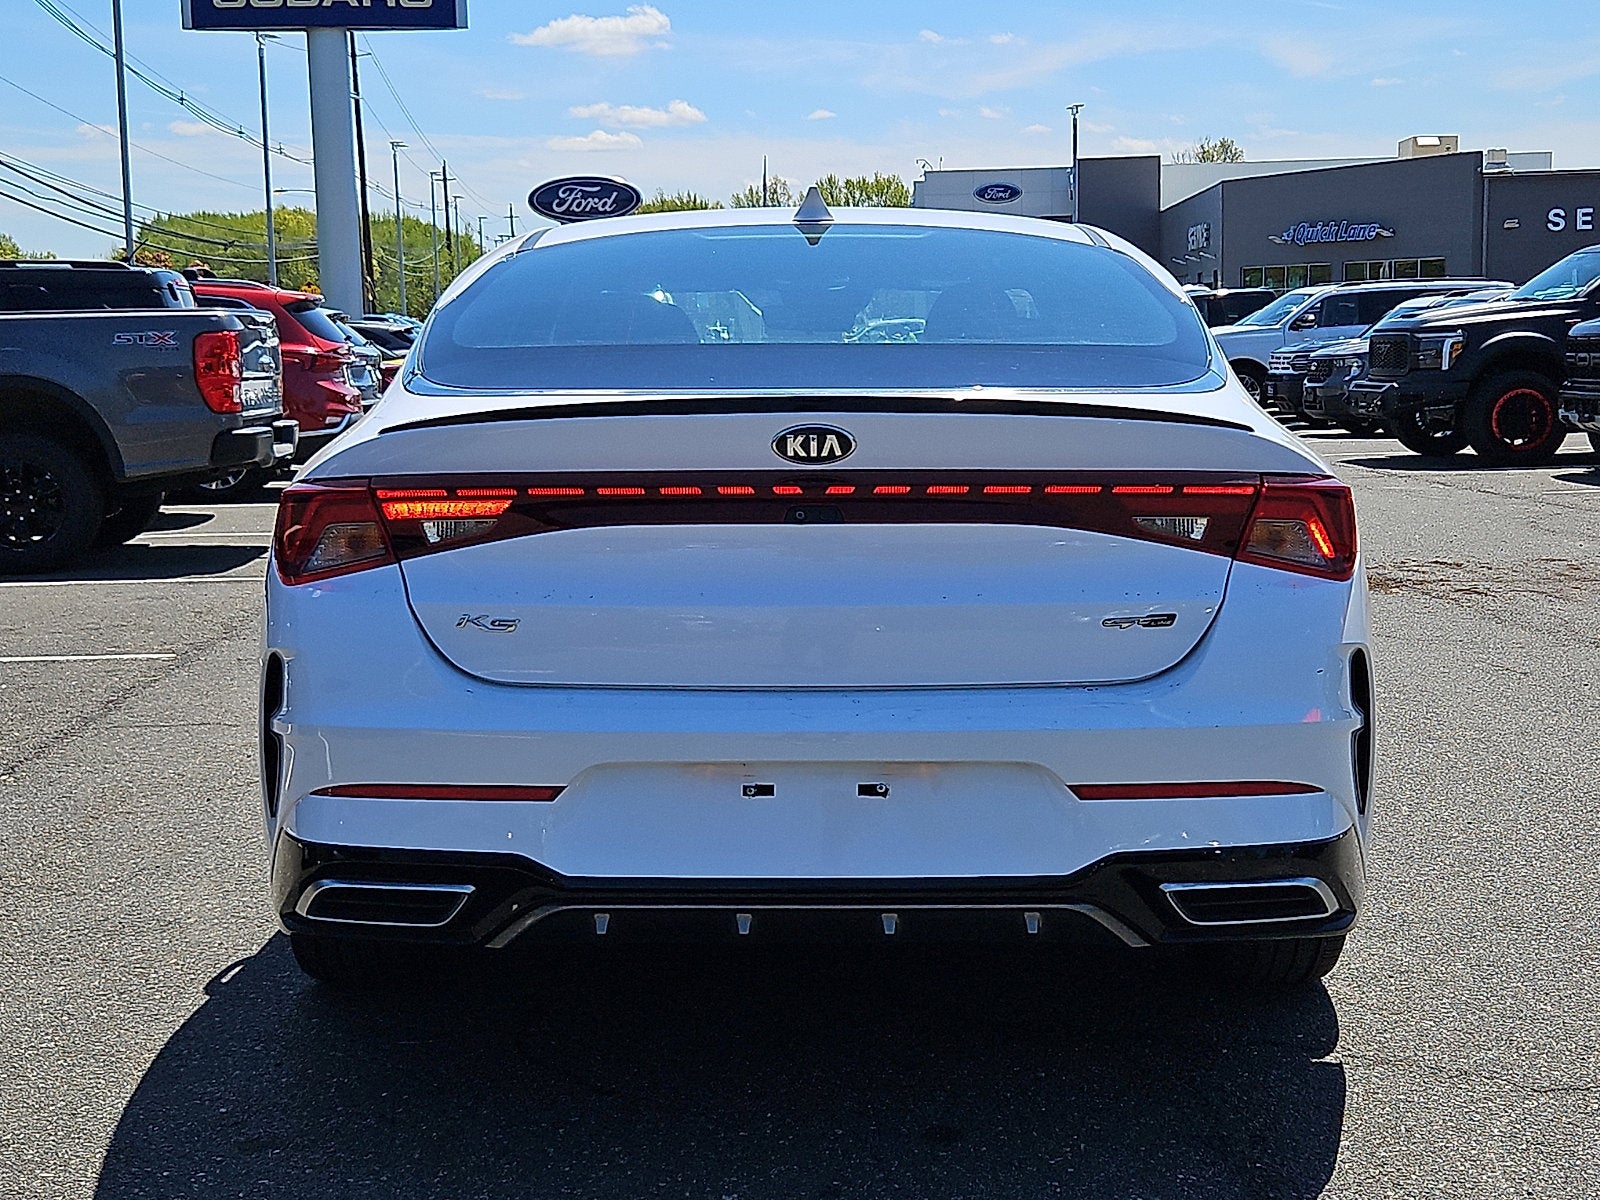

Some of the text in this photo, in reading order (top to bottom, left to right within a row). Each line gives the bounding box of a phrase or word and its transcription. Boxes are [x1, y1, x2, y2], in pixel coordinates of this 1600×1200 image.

[552, 185, 618, 213] Ford
[985, 187, 1011, 200] Ford
[1295, 220, 1380, 246] Quick Lane
[113, 331, 179, 347] STX
[786, 434, 843, 457] KIA
